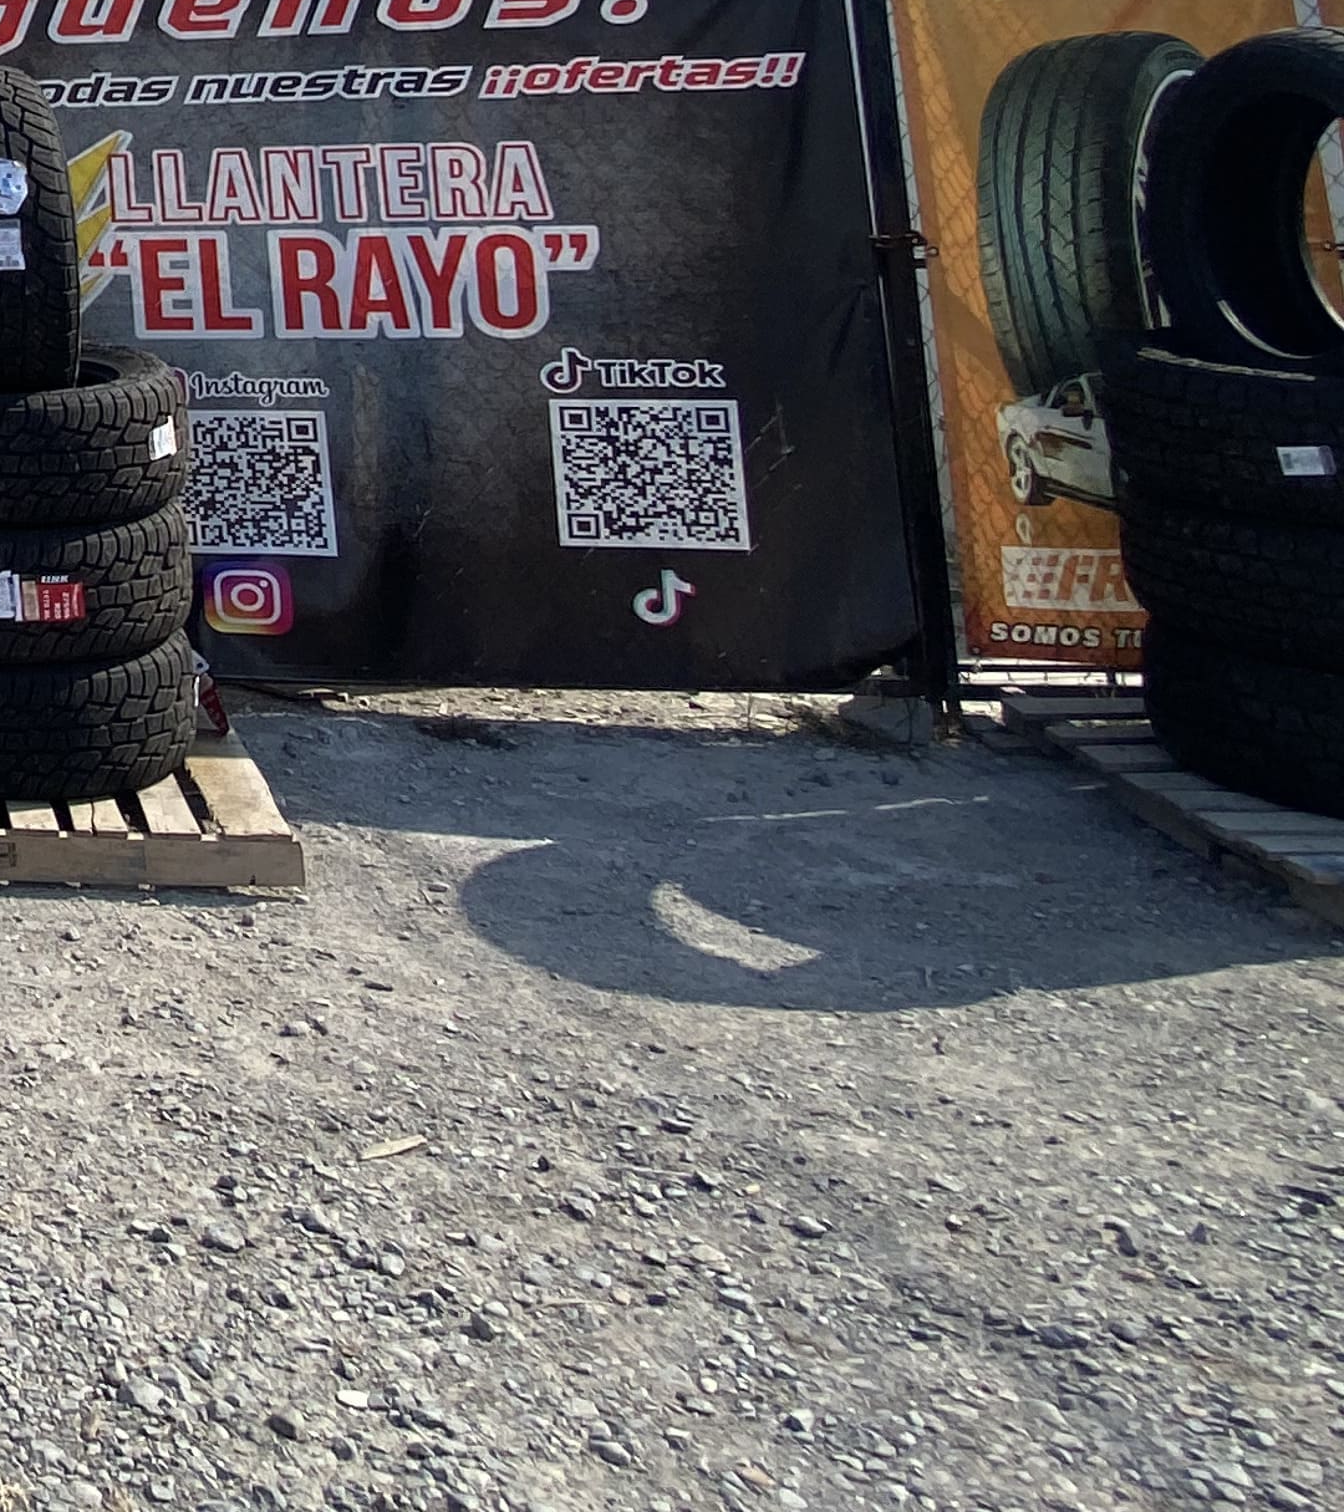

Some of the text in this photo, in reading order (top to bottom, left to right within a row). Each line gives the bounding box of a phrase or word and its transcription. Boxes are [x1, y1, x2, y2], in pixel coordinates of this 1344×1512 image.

[41, 71, 179, 108] odas
[183, 65, 473, 105] nuestras
[107, 140, 556, 227] LLANTERA
[189, 369, 330, 407] Instagram
[594, 359, 727, 390] TikTok
[990, 621, 1101, 648] SOMOS
